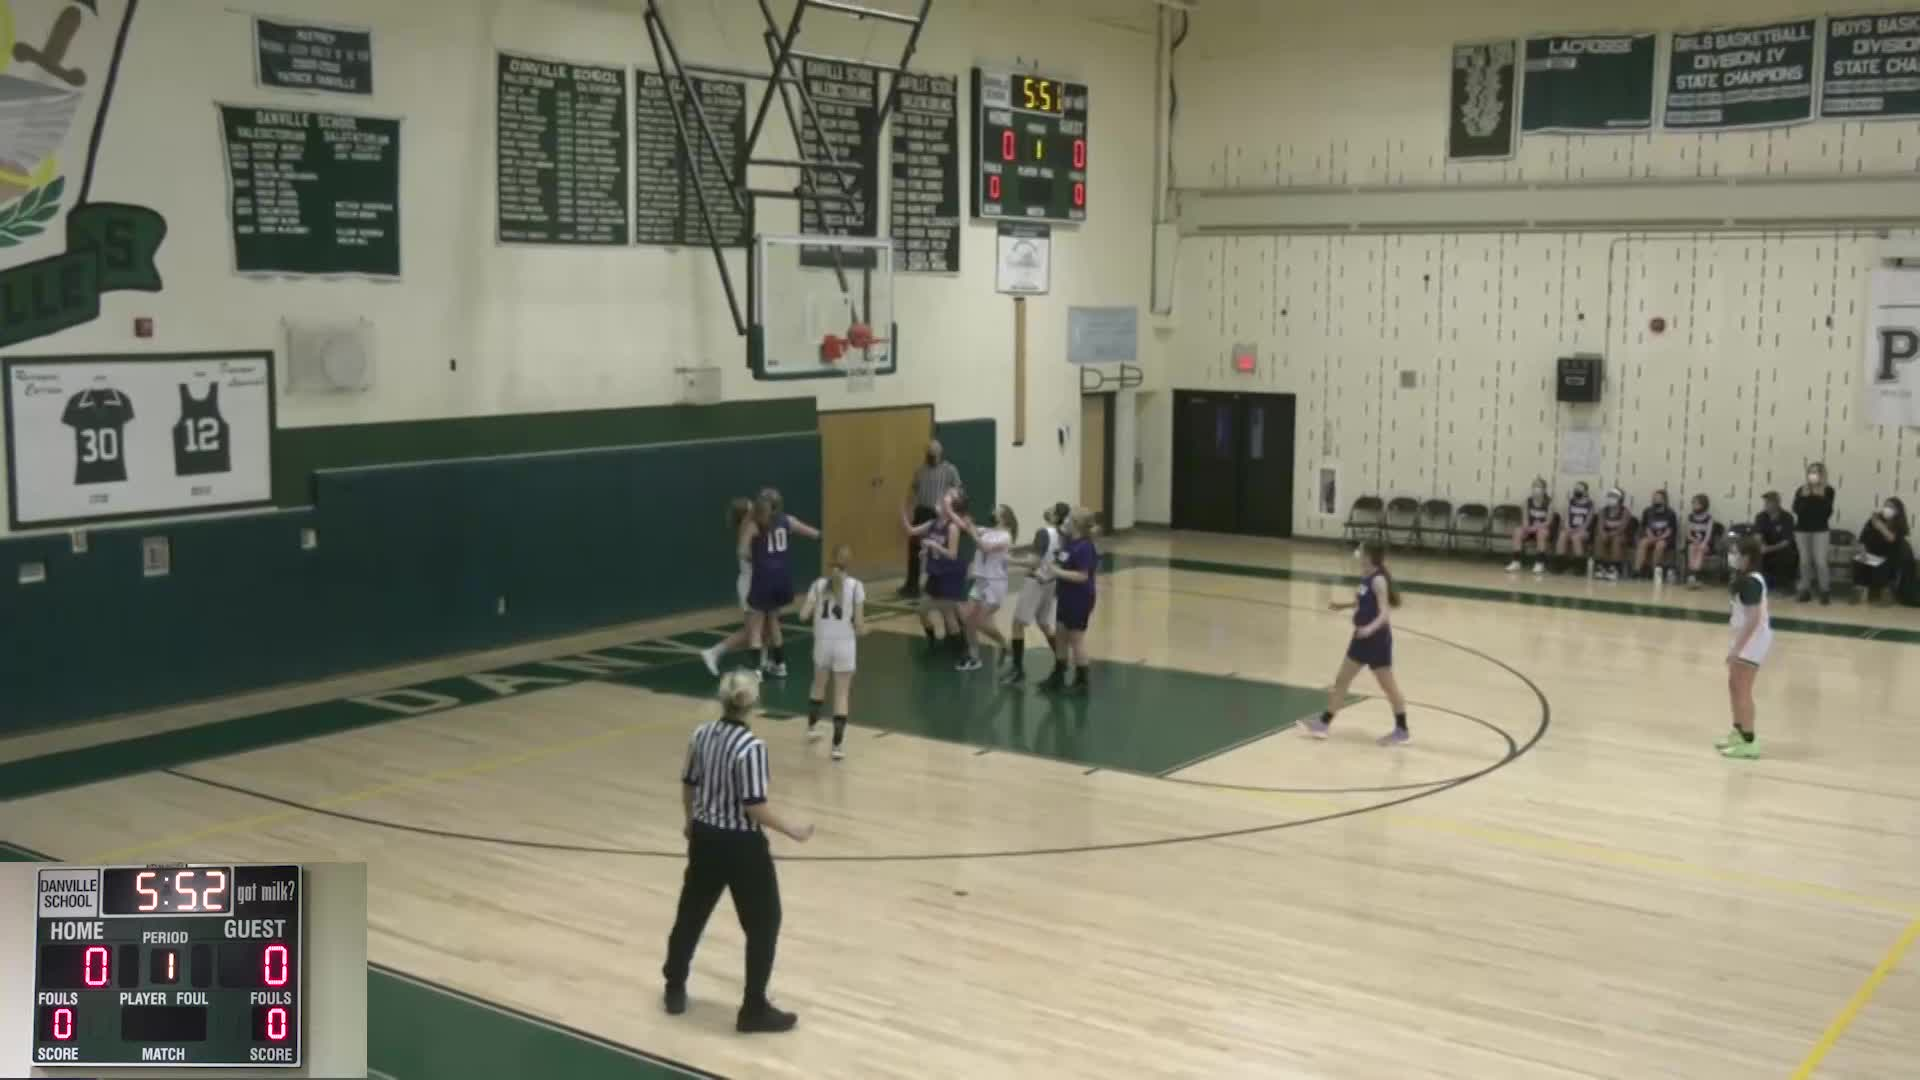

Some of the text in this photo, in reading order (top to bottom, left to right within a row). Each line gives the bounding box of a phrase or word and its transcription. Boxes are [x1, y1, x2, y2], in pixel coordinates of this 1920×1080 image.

[1676, 73, 1719, 90] STATE
[1723, 64, 1803, 86] CHAMPIONS
[1833, 60, 1880, 76] STATE
[1003, 131, 1015, 160] 0
[1073, 140, 1085, 168] 0
[80, 427, 119, 463] 30
[184, 416, 220, 452] 12
[767, 527, 787, 553] 10
